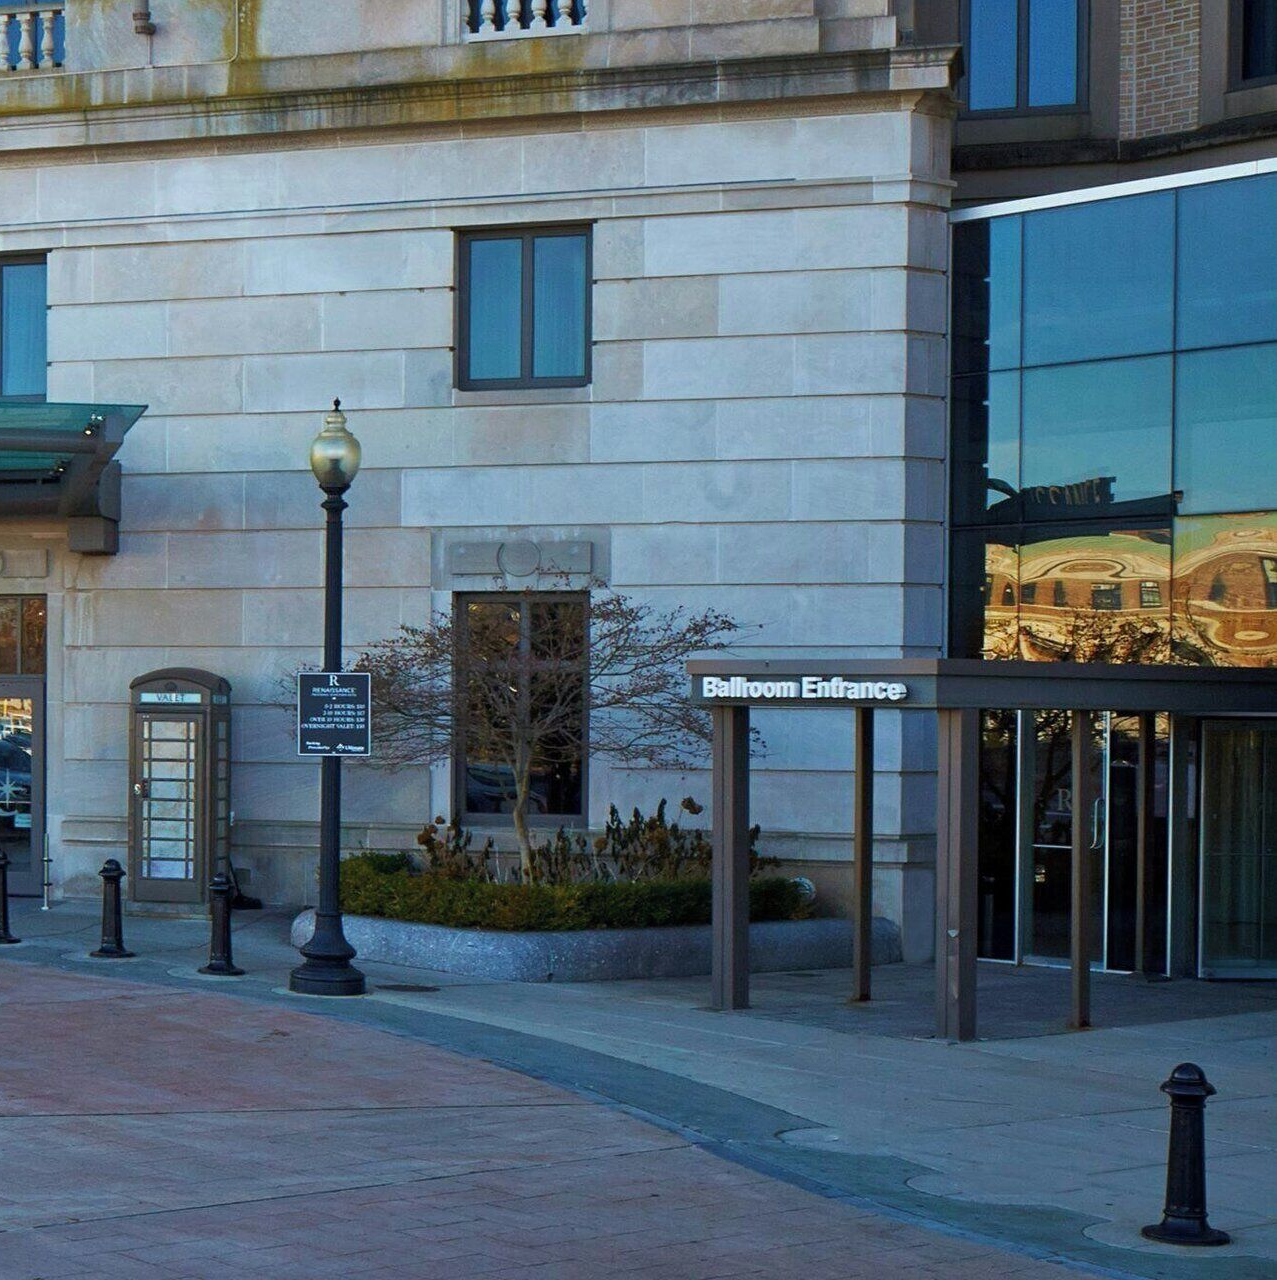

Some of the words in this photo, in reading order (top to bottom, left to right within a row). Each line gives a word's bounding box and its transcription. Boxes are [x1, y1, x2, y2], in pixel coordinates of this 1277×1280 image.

[329, 674, 340, 686] R
[702, 676, 800, 698] Ballroom
[801, 676, 907, 701] Entrance
[156, 694, 185, 702] VALET
